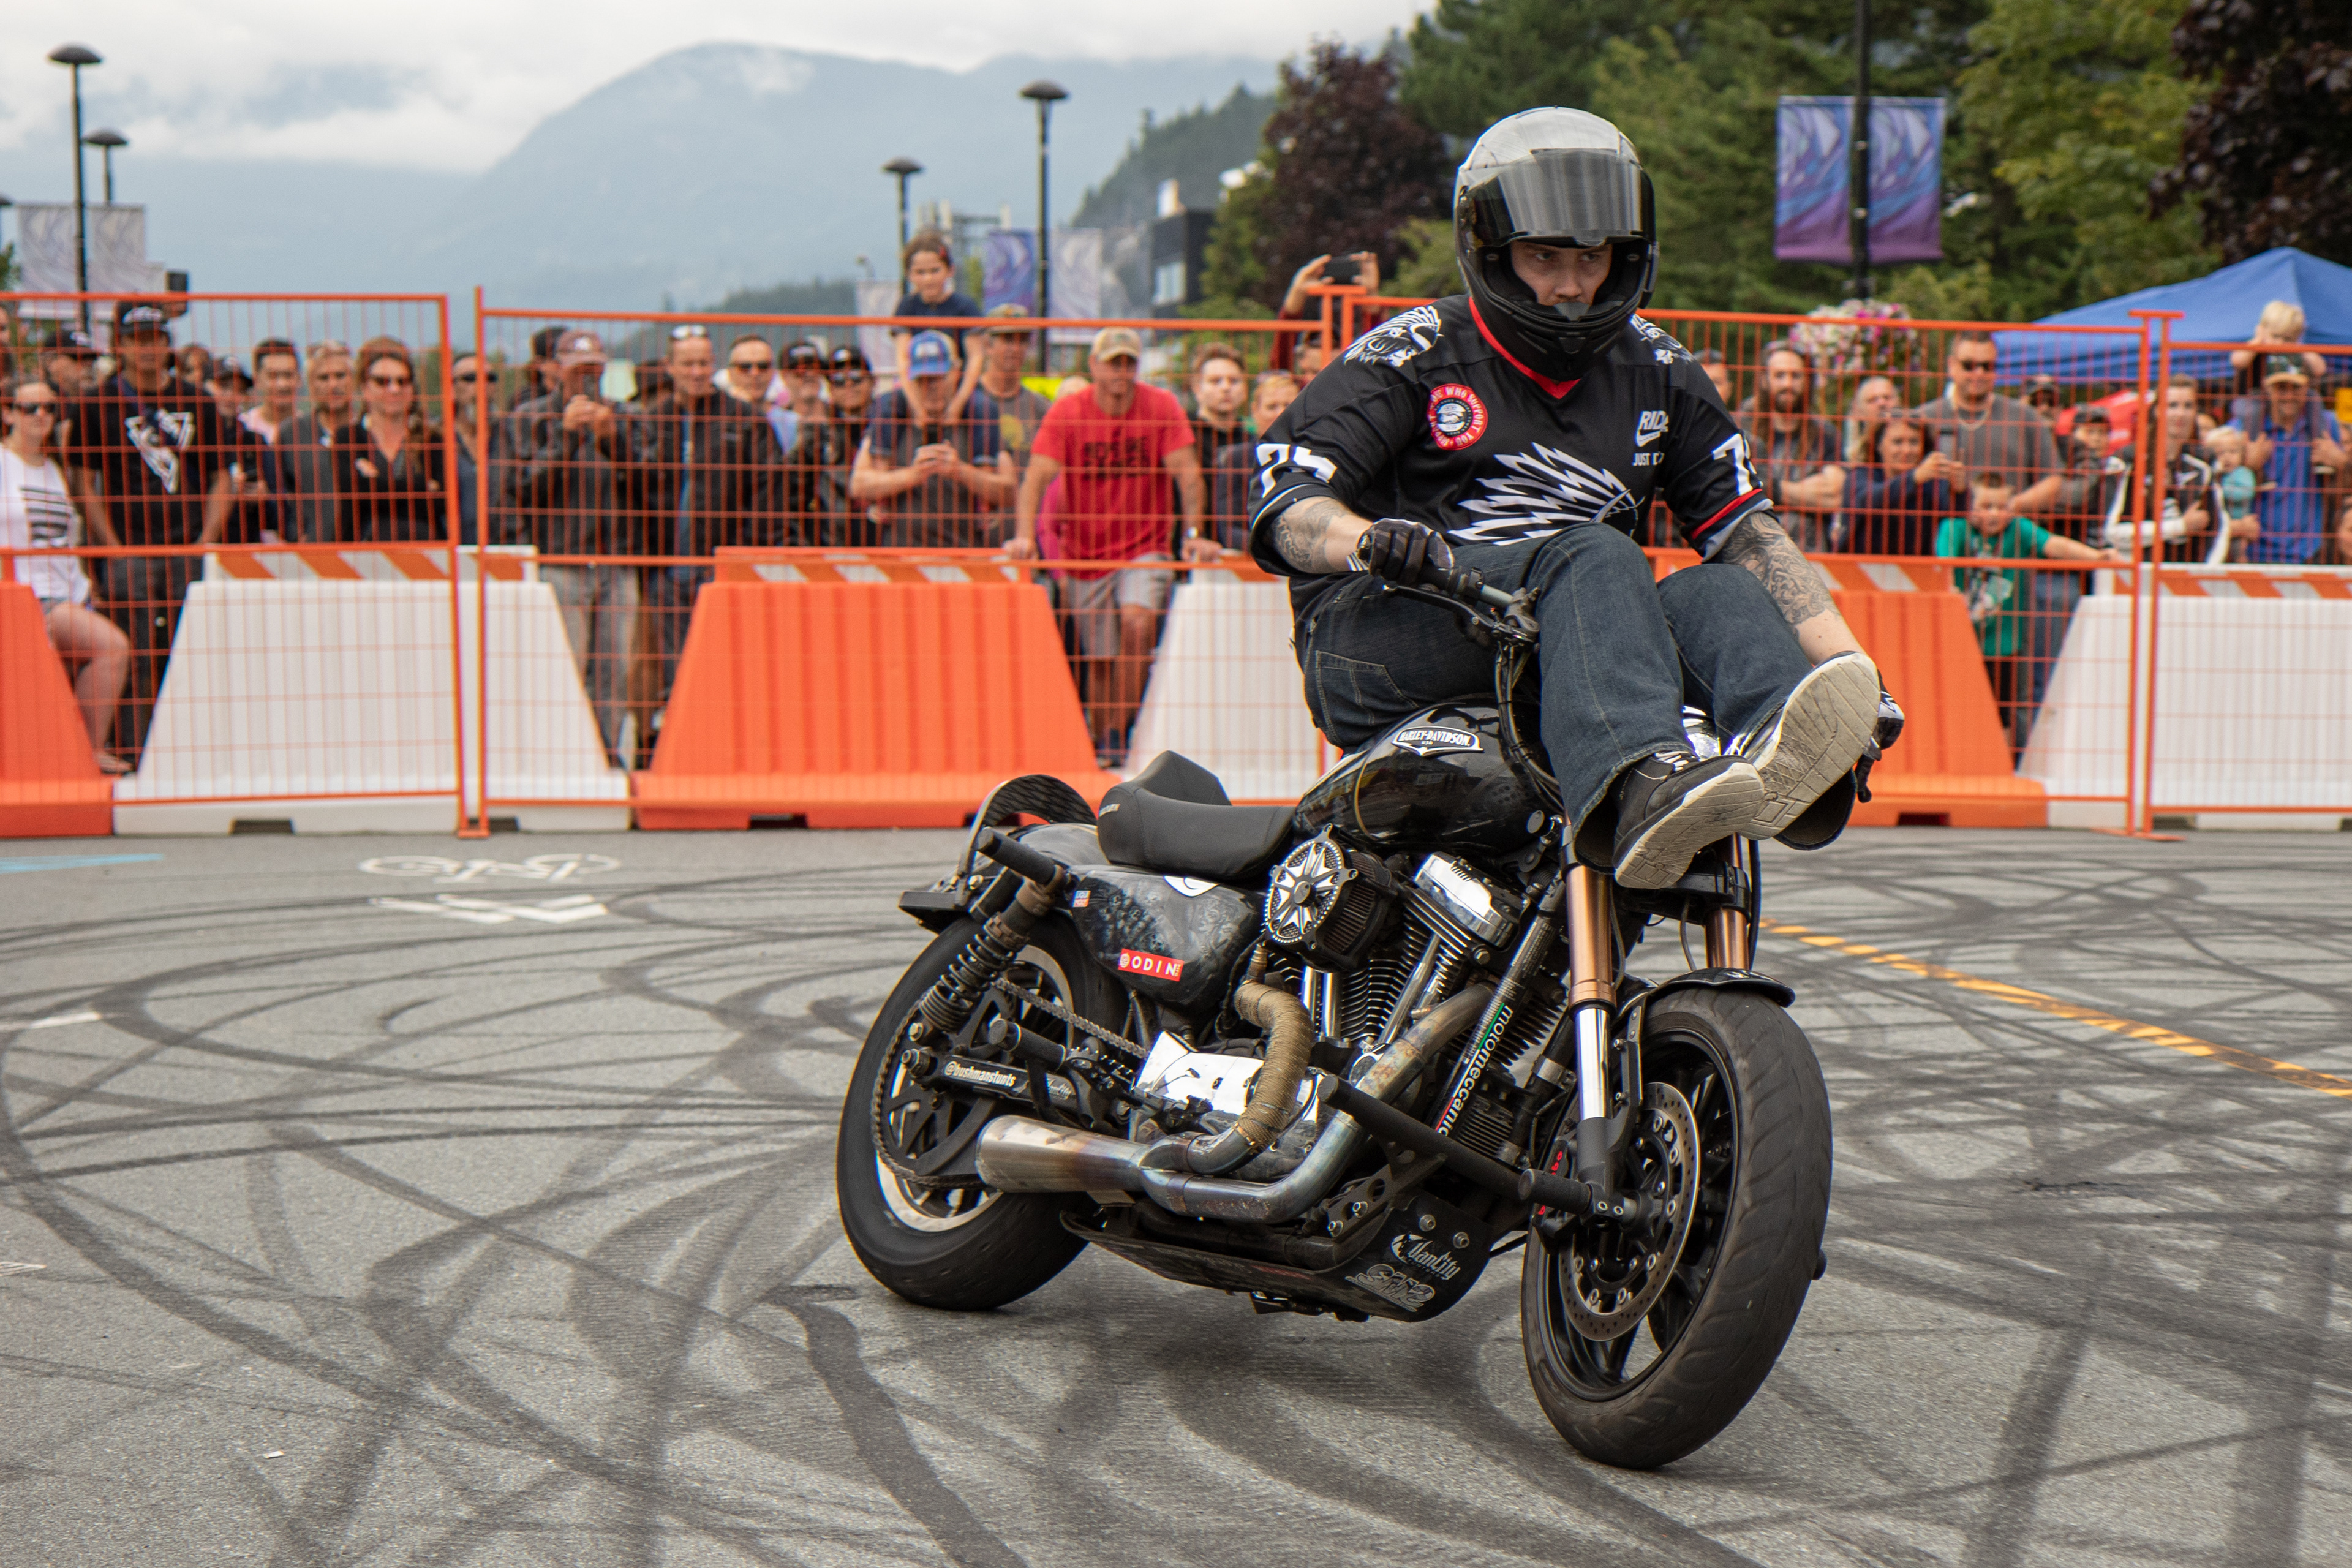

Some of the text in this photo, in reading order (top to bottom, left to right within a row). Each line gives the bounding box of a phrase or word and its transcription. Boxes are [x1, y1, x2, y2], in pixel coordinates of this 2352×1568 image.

[1445, 386, 1468, 398] WHO
[1468, 393, 1484, 433] SUPPORT
[1455, 432, 1474, 447] YOU
[1632, 453, 1651, 466] JUST
[1131, 956, 1177, 976] ODIN
[944, 1061, 1016, 1087] @bushmanstunts
